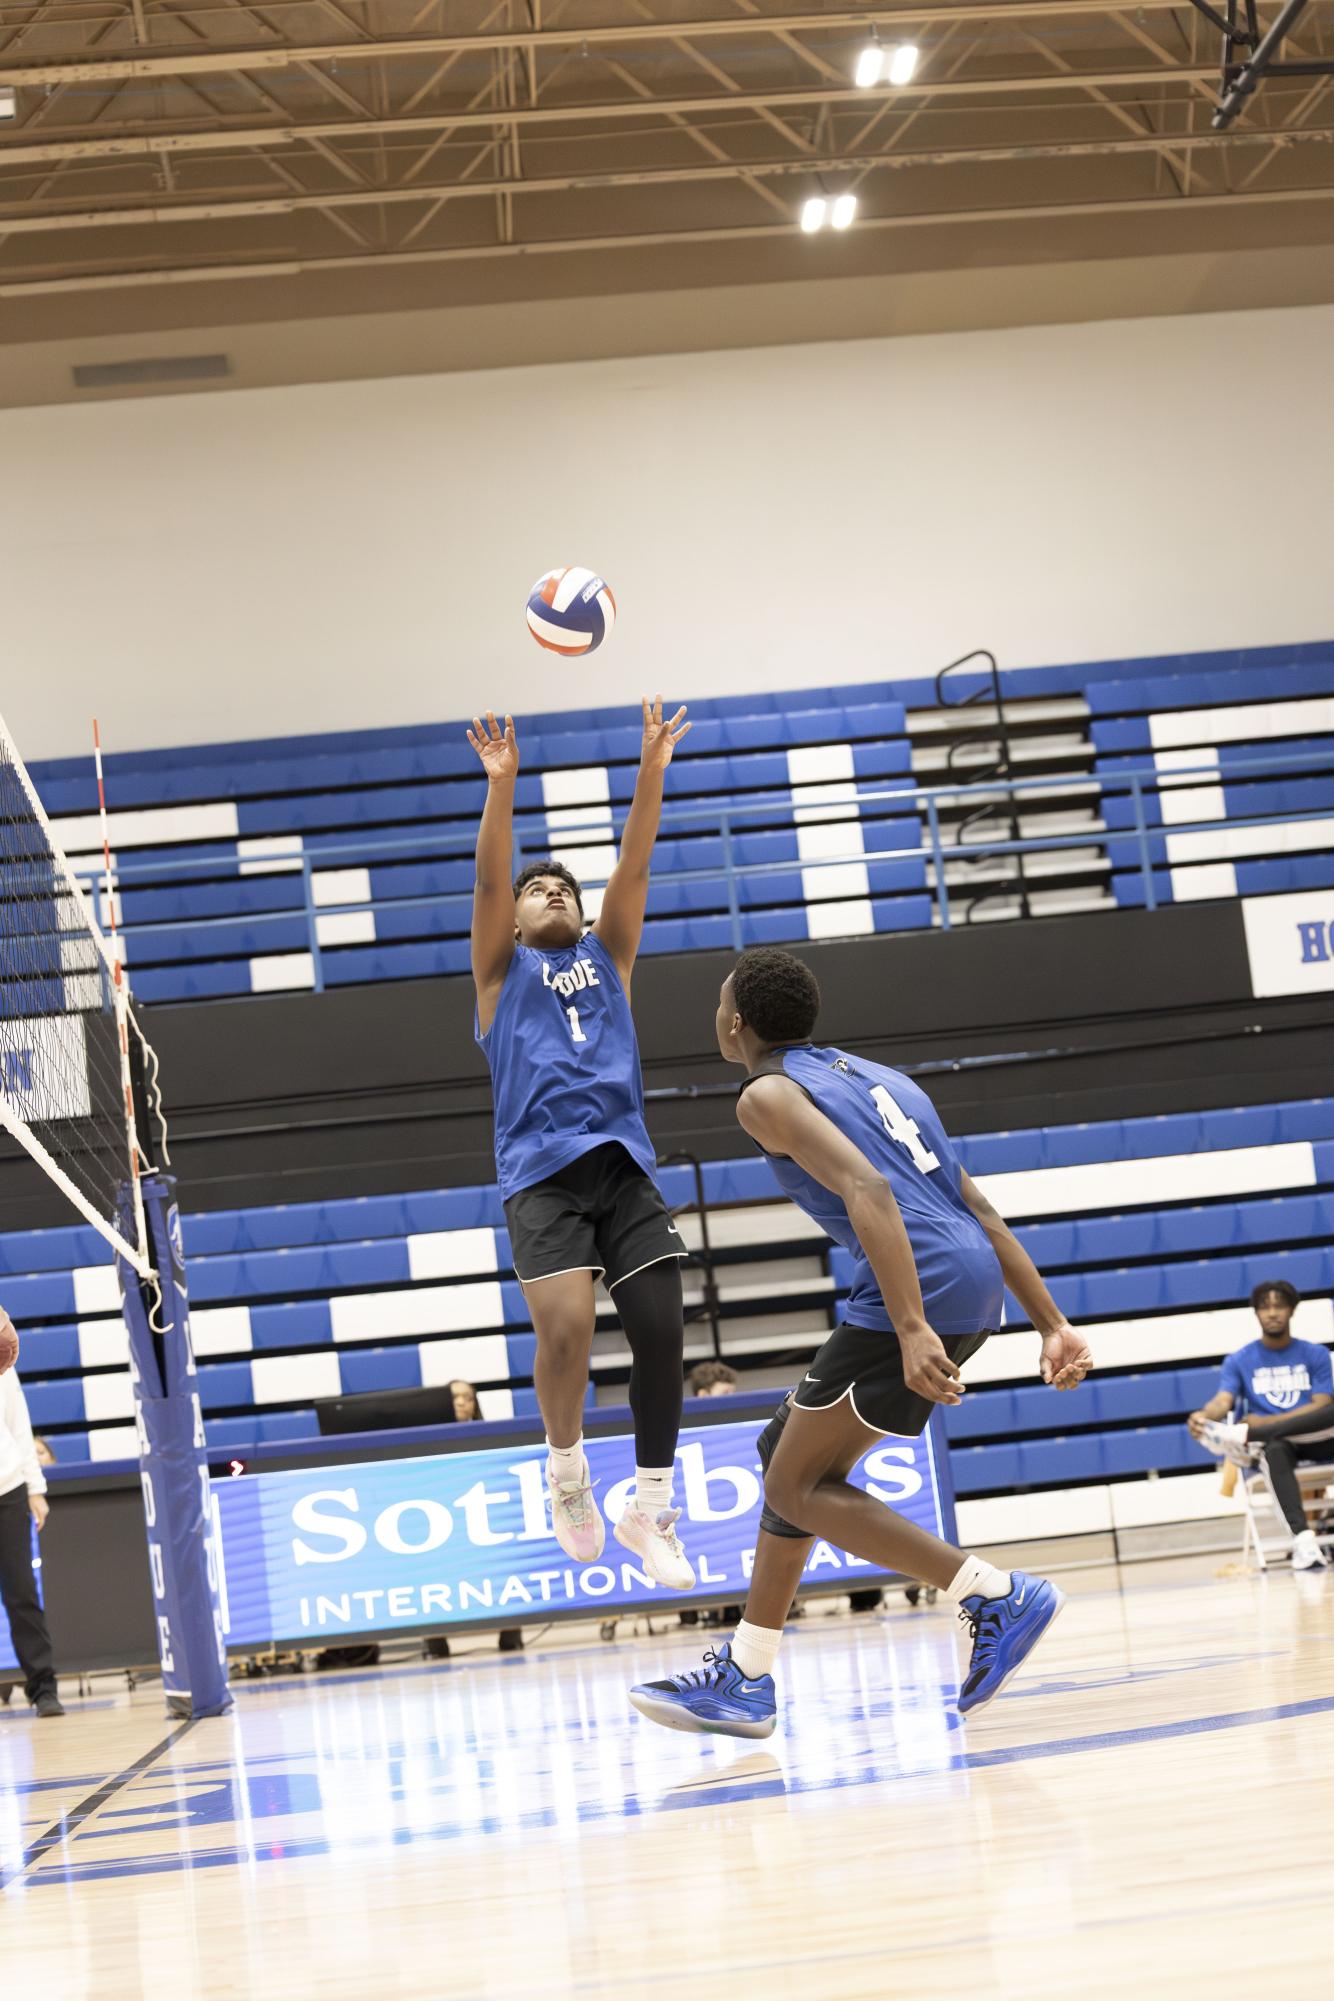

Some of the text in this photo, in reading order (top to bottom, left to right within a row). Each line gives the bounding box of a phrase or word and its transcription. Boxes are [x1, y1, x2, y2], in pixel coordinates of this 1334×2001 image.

[1297, 920, 1334, 963] H
[566, 1005, 587, 1042] 1
[868, 1084, 941, 1174] 4
[300, 1554, 727, 1626] INTERNATIONL
